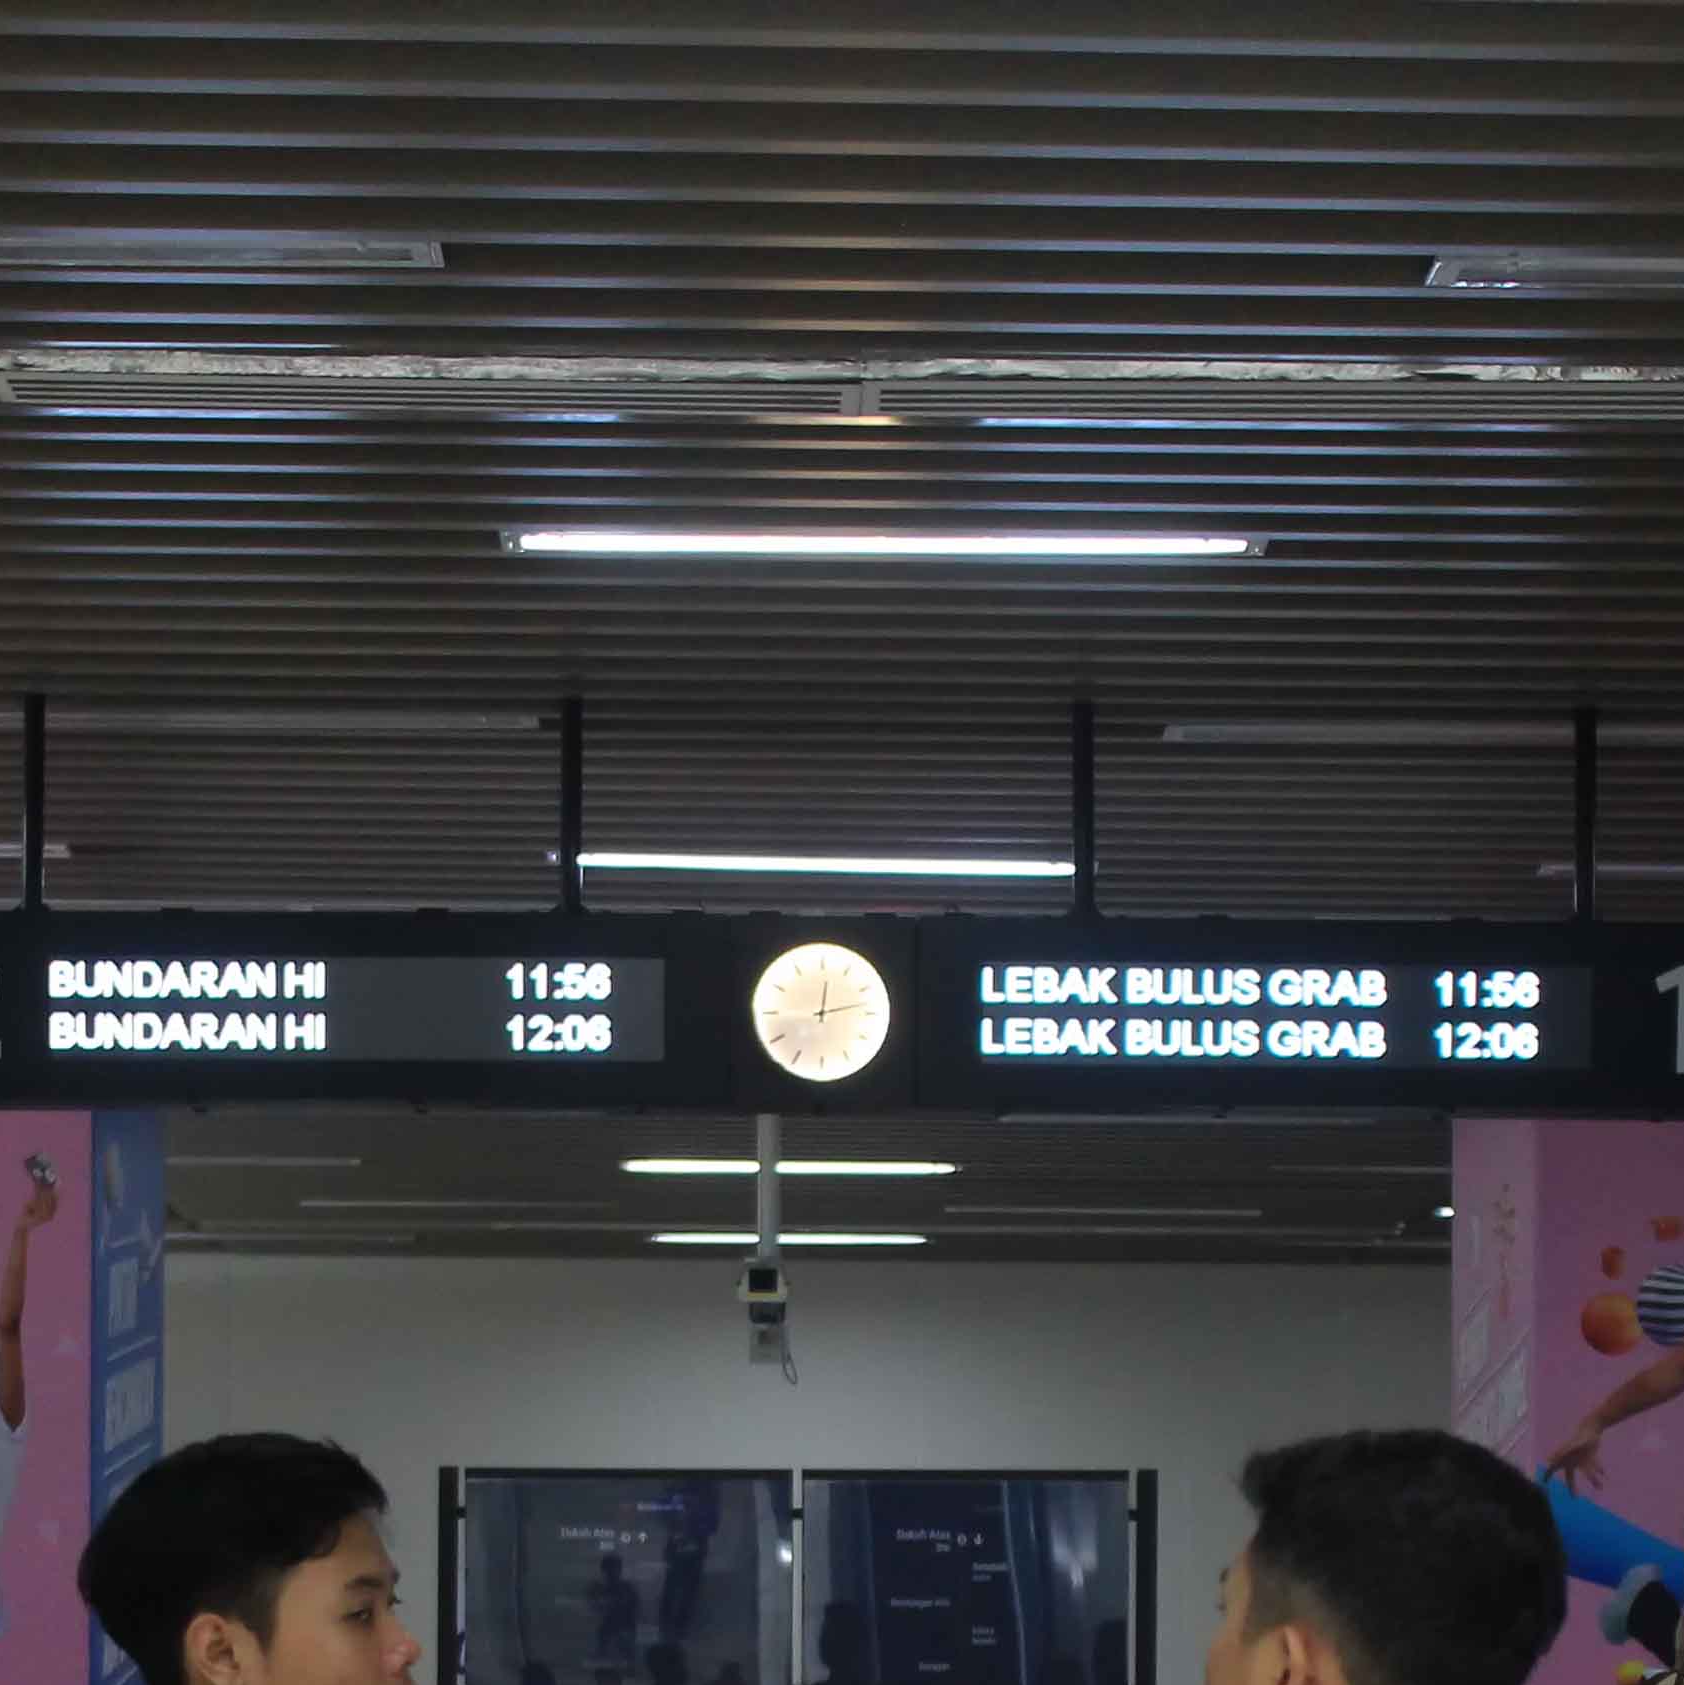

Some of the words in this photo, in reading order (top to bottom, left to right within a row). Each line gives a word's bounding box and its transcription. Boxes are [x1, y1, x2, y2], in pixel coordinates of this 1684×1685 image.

[48, 960, 278, 999] BUNDARAN
[283, 961, 327, 998] HI
[504, 962, 613, 1000] 11:56
[980, 966, 1116, 1004] LEBAK
[1124, 968, 1261, 1006] BULUS
[1266, 969, 1387, 1007] GRAB
[1433, 970, 1540, 1008] 11:56
[48, 1012, 278, 1051] BUNDARAN
[283, 1013, 327, 1050] HI
[504, 1013, 613, 1052] 12:06
[980, 1018, 1116, 1056] LEBAK
[1124, 1019, 1261, 1057] BULUS
[1266, 1020, 1387, 1058] GRAB
[1431, 1021, 1539, 1059] 12:06
